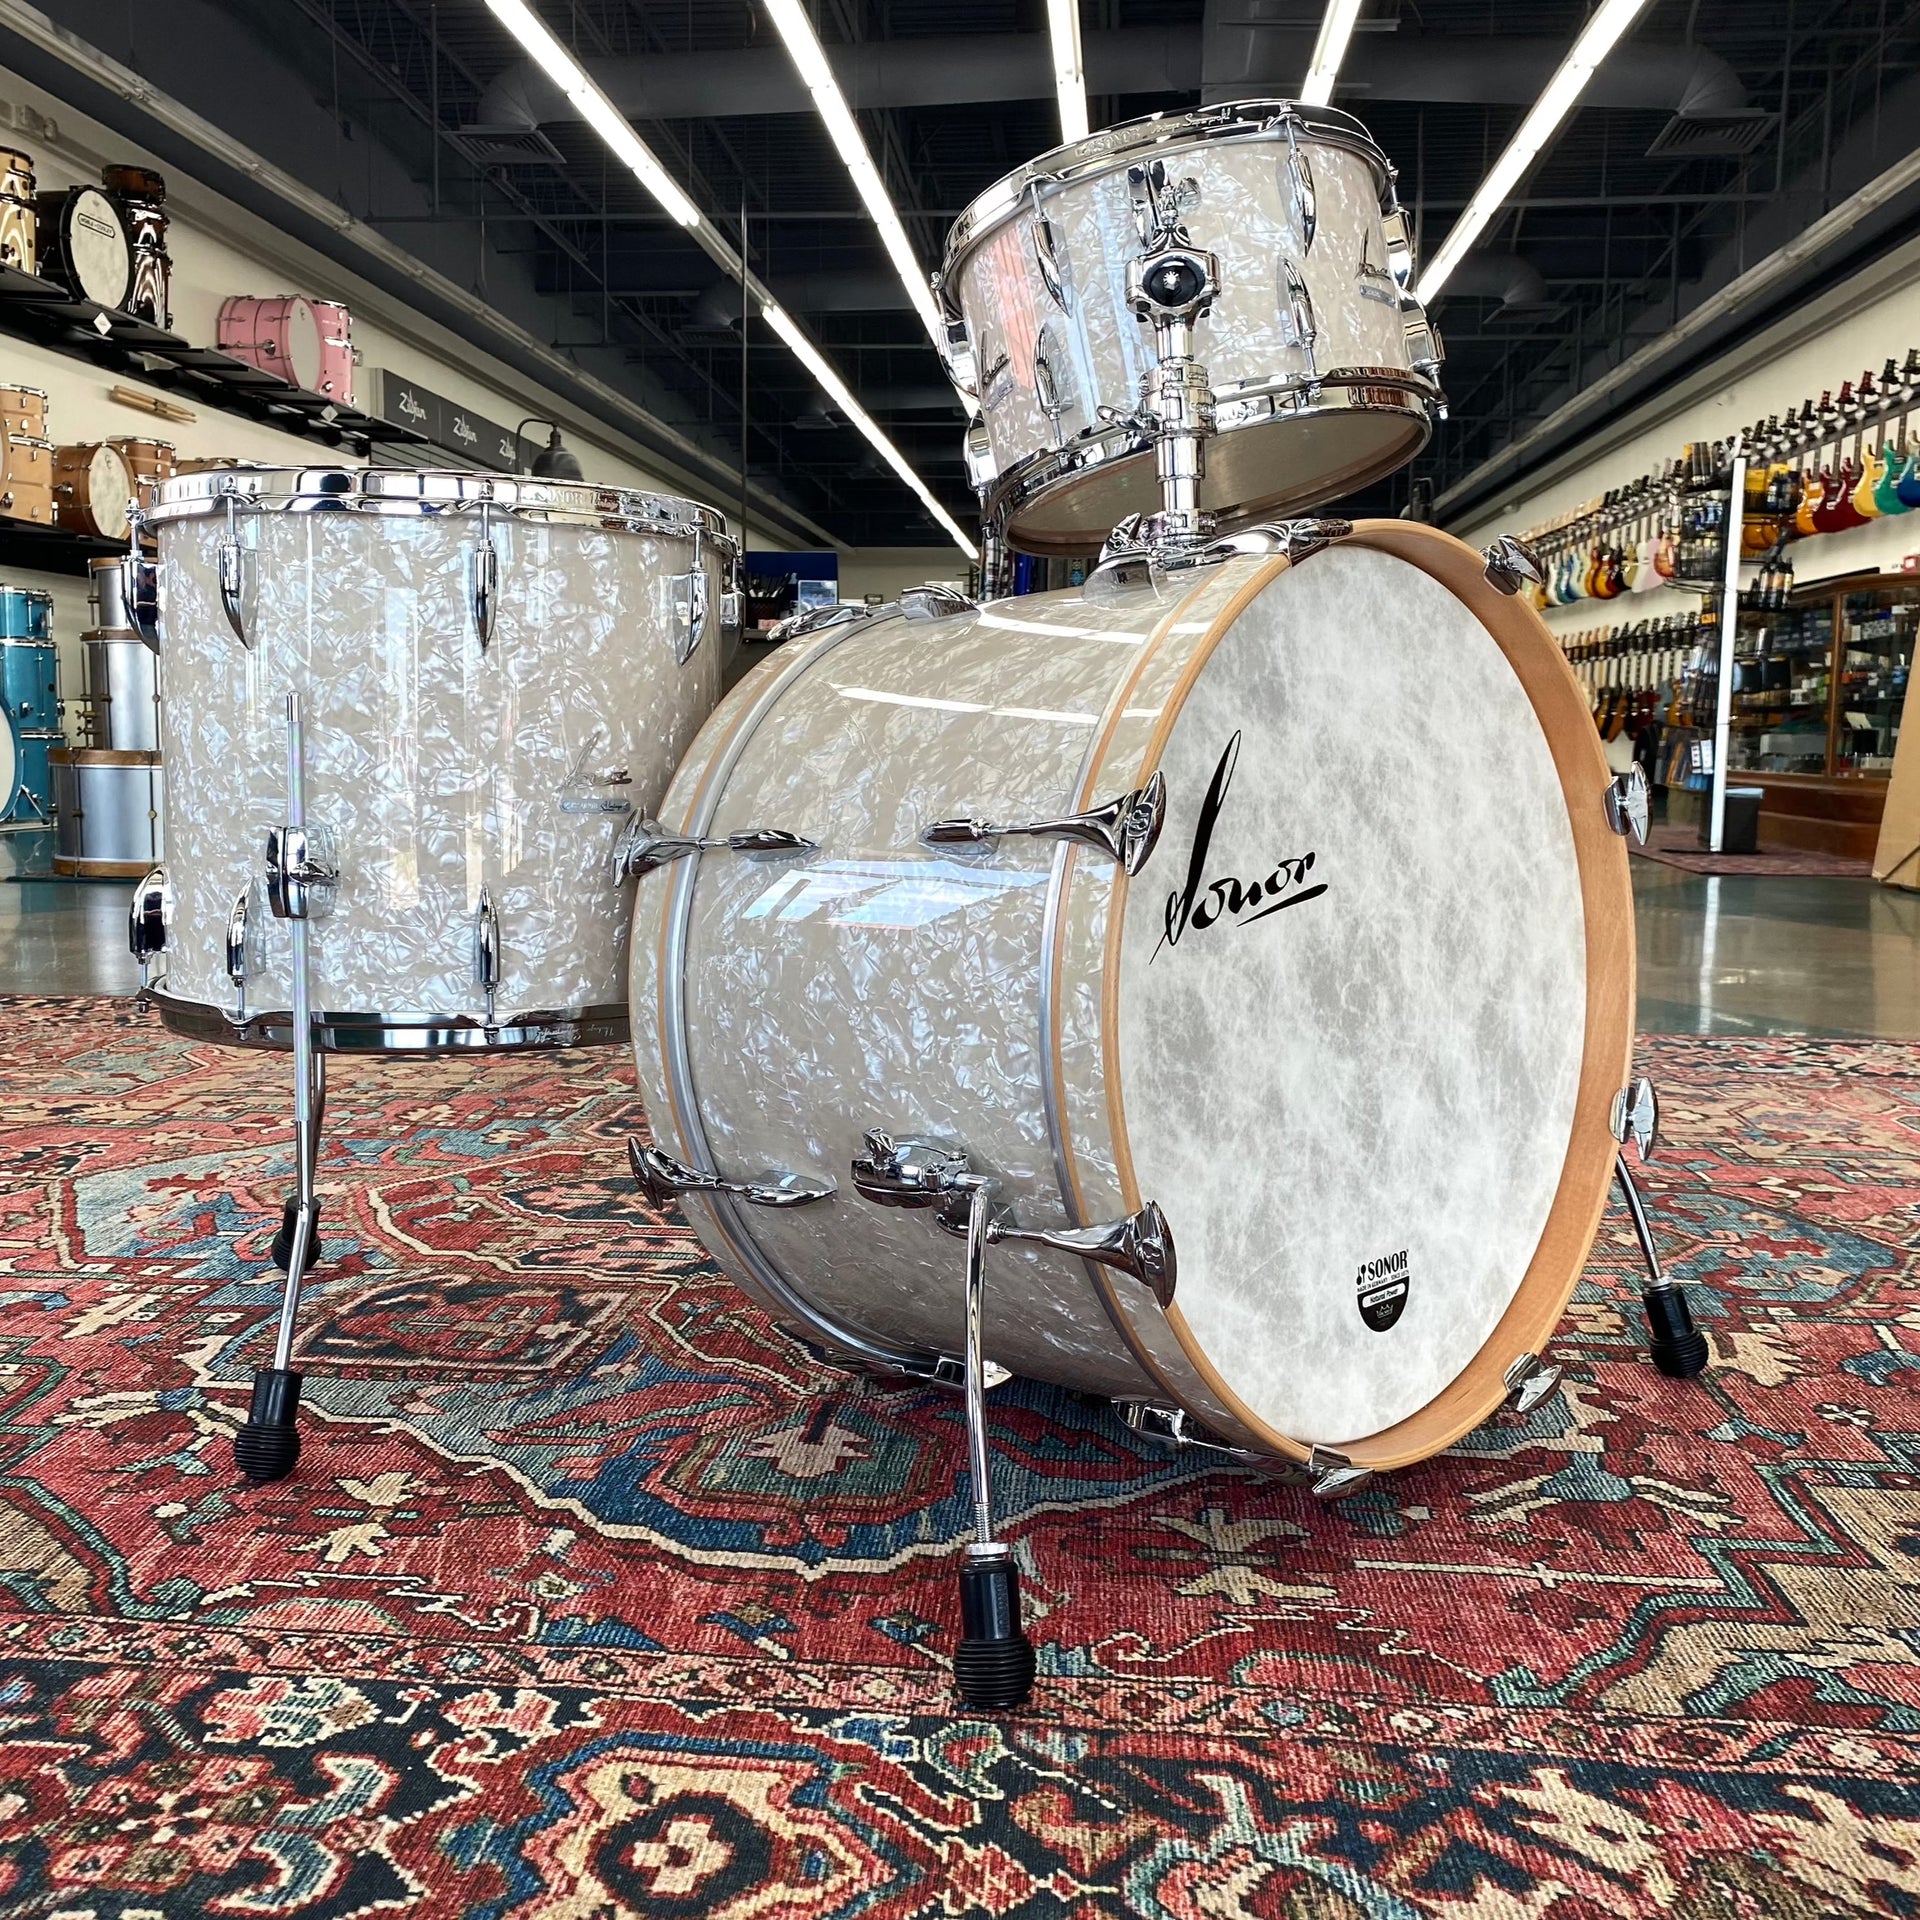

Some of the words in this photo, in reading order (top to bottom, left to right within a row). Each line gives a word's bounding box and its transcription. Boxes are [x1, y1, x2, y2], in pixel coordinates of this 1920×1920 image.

[399, 389, 427, 423] Zildjian
[453, 414, 477, 446] Zildjian
[1149, 729, 1329, 965] Sonor
[1367, 1250, 1408, 1281] SONOR
